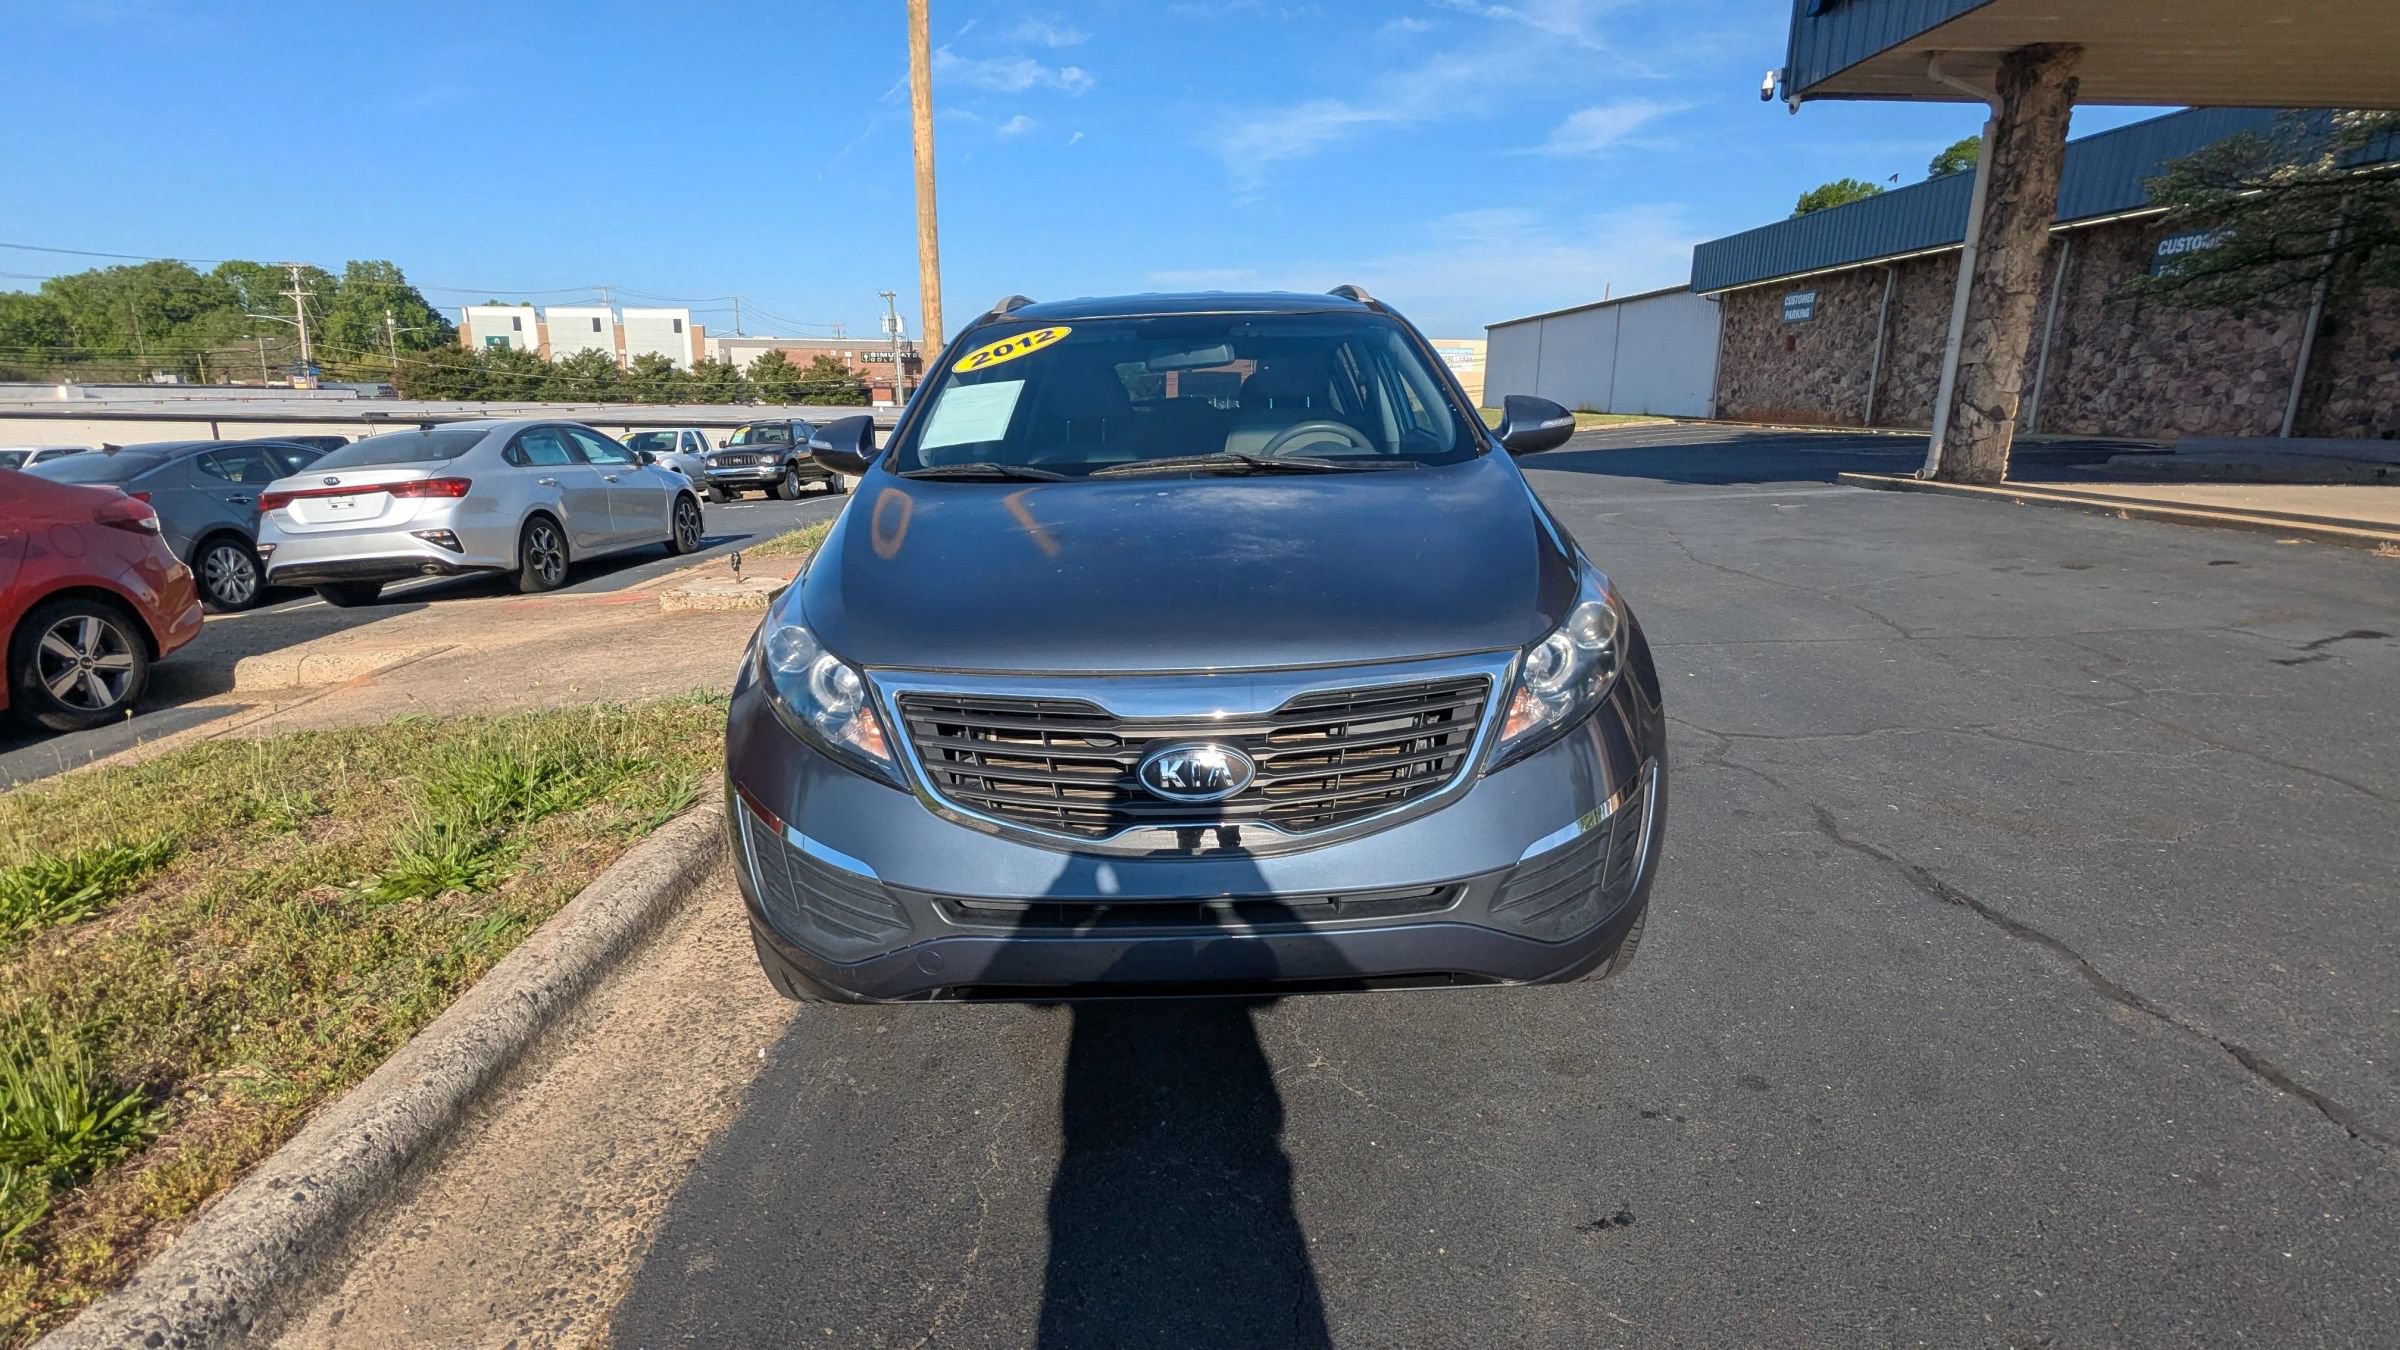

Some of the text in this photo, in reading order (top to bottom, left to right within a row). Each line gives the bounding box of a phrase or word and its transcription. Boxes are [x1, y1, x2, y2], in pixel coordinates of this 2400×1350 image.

[1784, 292, 1815, 306] CUSTOMER
[1784, 308, 1810, 320] PARKING
[970, 330, 1058, 368] 2012
[1158, 758, 1235, 788] KIA
